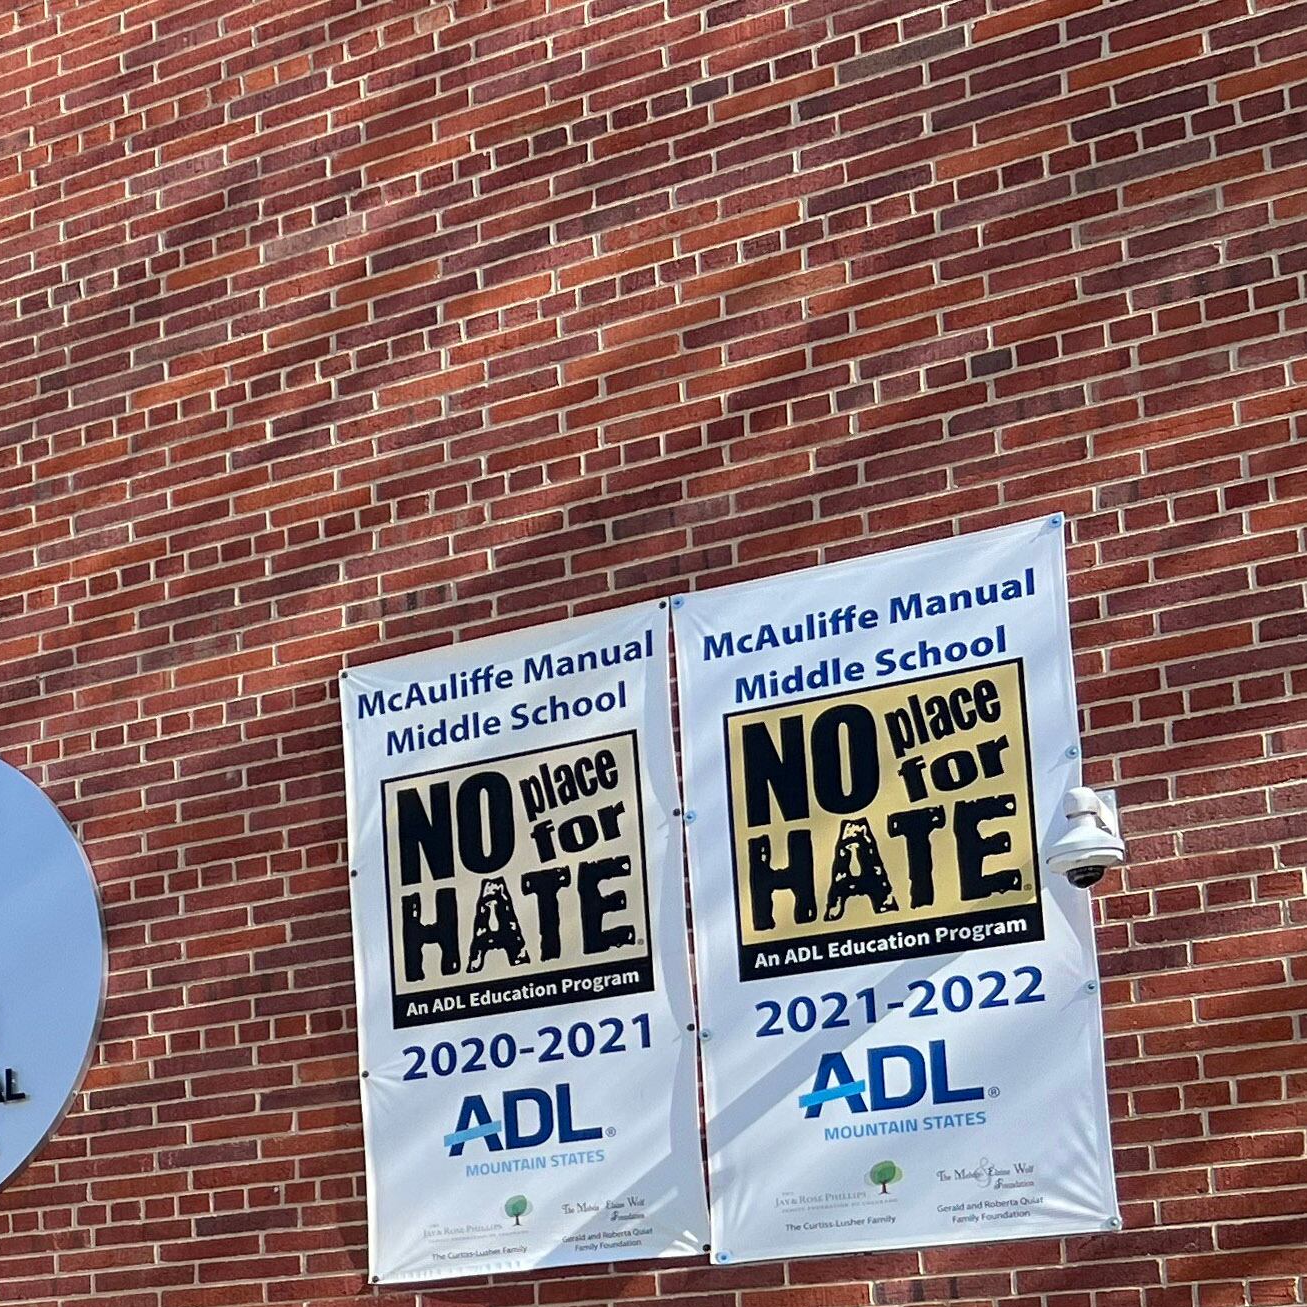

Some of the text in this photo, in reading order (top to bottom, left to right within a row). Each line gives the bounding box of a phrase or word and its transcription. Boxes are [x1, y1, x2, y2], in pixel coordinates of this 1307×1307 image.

[703, 567, 1035, 661] McAuliffe Manual
[357, 629, 654, 719] McAuliffe Manual
[735, 624, 1007, 703] Middle School
[386, 680, 627, 756] Middle School
[742, 678, 1002, 828] NO place
[897, 734, 1010, 803] for
[396, 749, 619, 887] NO place
[530, 800, 626, 864] for
[748, 793, 1023, 932] HATE
[400, 855, 636, 983] HATE
[754, 917, 1028, 969] An ADL Education Program
[406, 970, 640, 1017] An ADL Education Program
[755, 965, 1046, 1038] 2021-2022
[402, 1012, 652, 1082] 2020-2021
[799, 1039, 985, 1120] ADL
[444, 1082, 604, 1157] ADL
[824, 1111, 987, 1141] MOUNTAIN STATES
[465, 1149, 605, 1178] MOUNTAIN STATES
[786, 1223, 801, 1231] The
[867, 1215, 897, 1225] Family
[952, 1210, 1031, 1223] Family Foundation
[966, 1201, 983, 1210] and
[600, 1239, 642, 1249] Foundation
